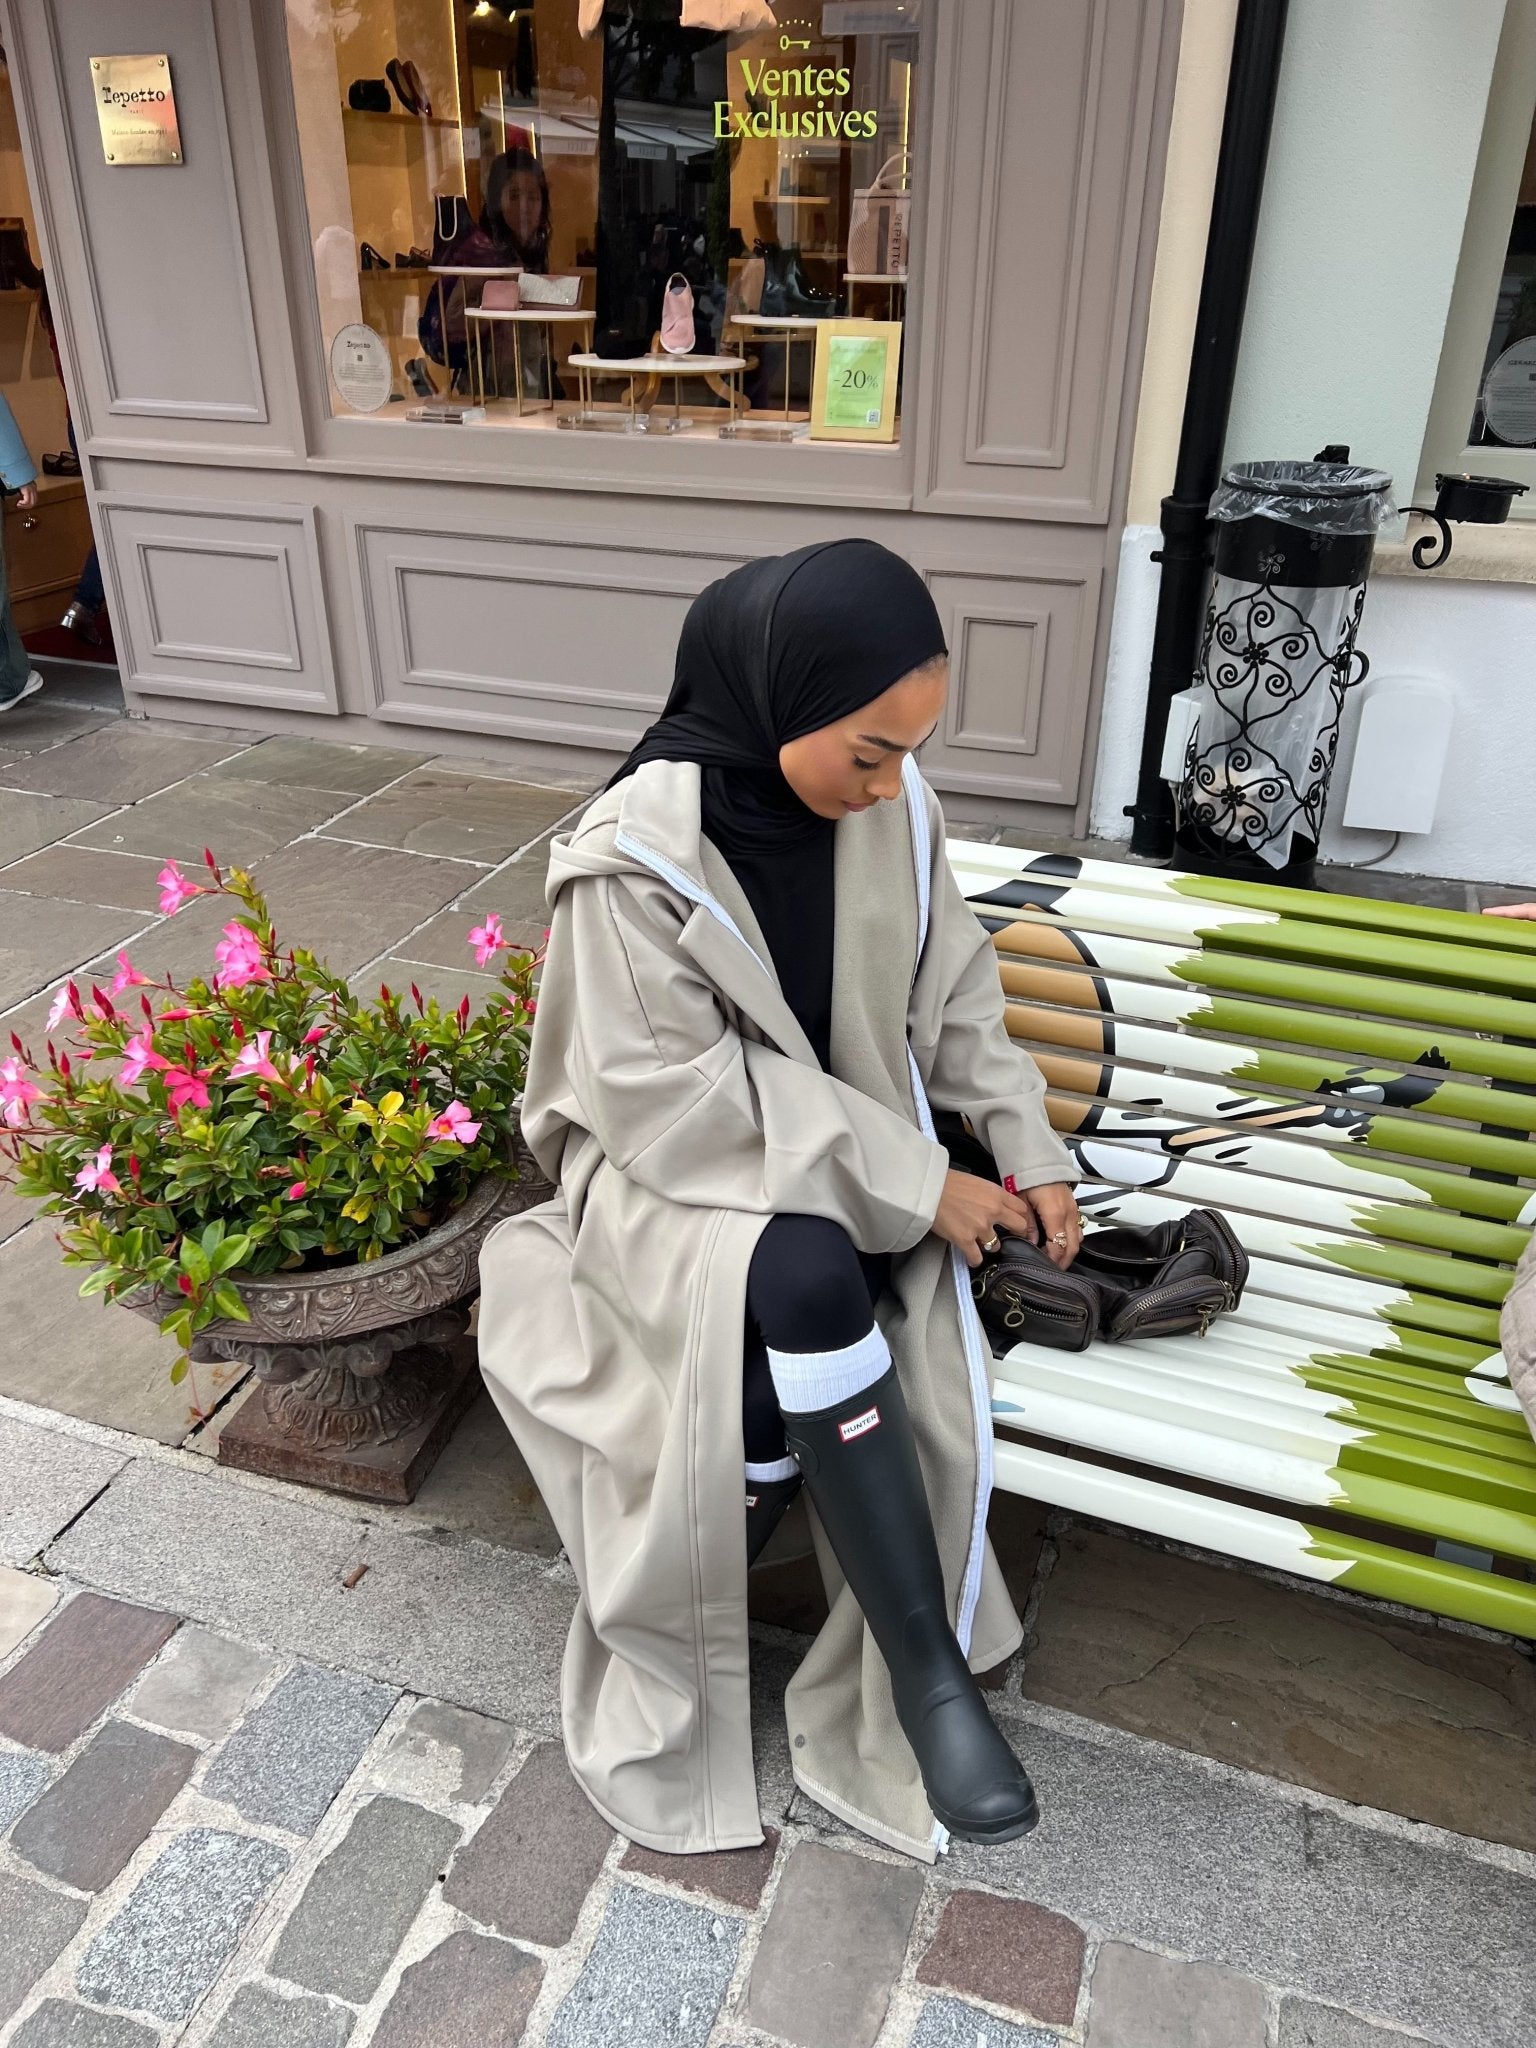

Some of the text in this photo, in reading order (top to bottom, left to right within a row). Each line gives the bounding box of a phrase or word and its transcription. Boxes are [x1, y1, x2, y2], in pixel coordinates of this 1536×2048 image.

[739, 58, 850, 97] Ventes
[102, 86, 166, 108] repetto
[713, 99, 878, 138] Exclusives
[891, 213, 903, 268] REPETTO
[833, 369, 879, 390] -20%
[843, 1413, 877, 1435] HUNTER
